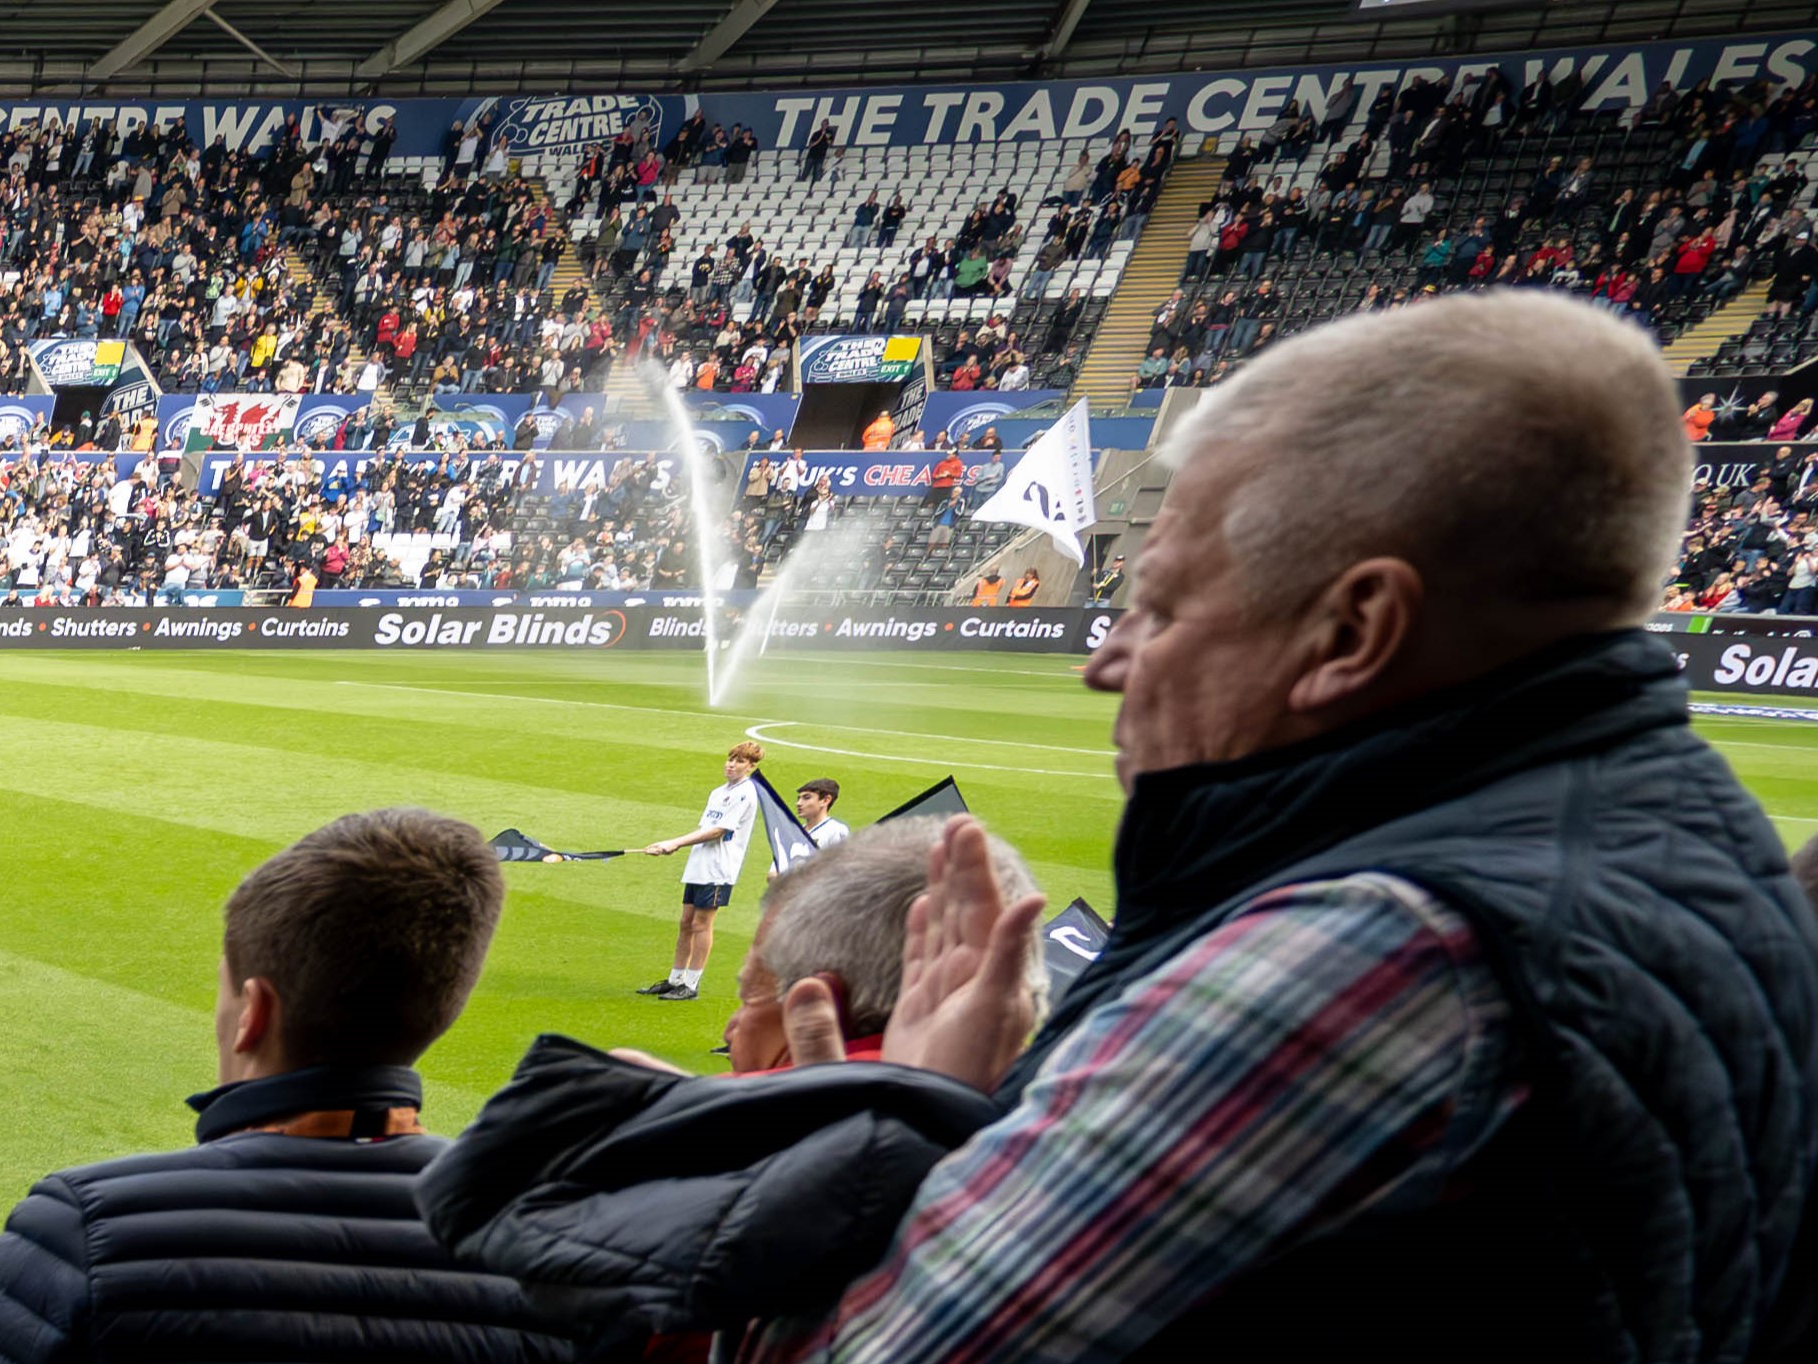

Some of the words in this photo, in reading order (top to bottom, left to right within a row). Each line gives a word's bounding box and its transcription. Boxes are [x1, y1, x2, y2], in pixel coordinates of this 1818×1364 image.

[527, 110, 624, 145] CENTRE
[774, 94, 904, 148] THE
[922, 82, 1171, 143] TRADE
[92, 367, 113, 380] EXIT
[880, 363, 903, 375] EXIT
[51, 616, 137, 638] Shutters
[154, 617, 242, 640] Awnings
[261, 617, 349, 638] Curtains
[374, 614, 479, 645] Solar
[486, 613, 612, 645] Blinds
[835, 617, 937, 642] Awnings
[959, 617, 1065, 640] Curtains
